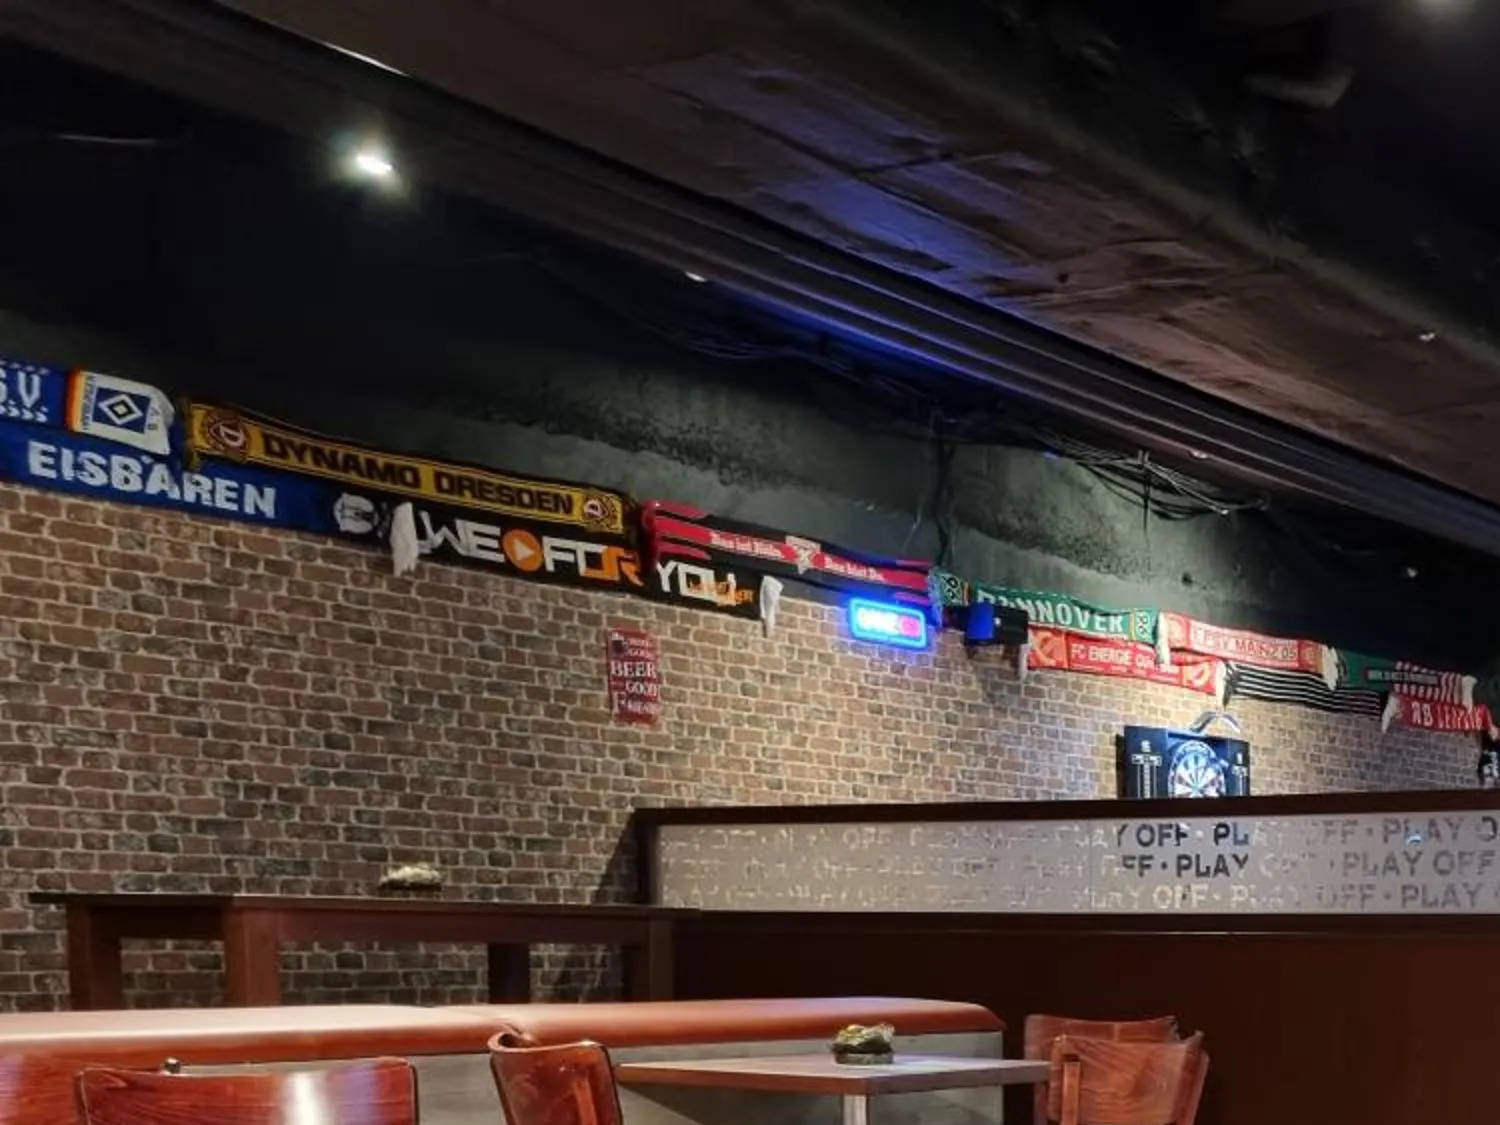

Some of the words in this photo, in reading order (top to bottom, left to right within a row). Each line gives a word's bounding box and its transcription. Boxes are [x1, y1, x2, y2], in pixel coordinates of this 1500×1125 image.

[263, 430, 421, 489] DYNAMO
[435, 469, 574, 515] DRESDEN
[611, 661, 657, 679] BEER
[1135, 823, 1189, 848] OFF
[1175, 853, 1249, 878] PLAY
[1342, 851, 1423, 878] PLAY
[1432, 849, 1496, 876] OFF
[1401, 881, 1483, 908] PLAY
